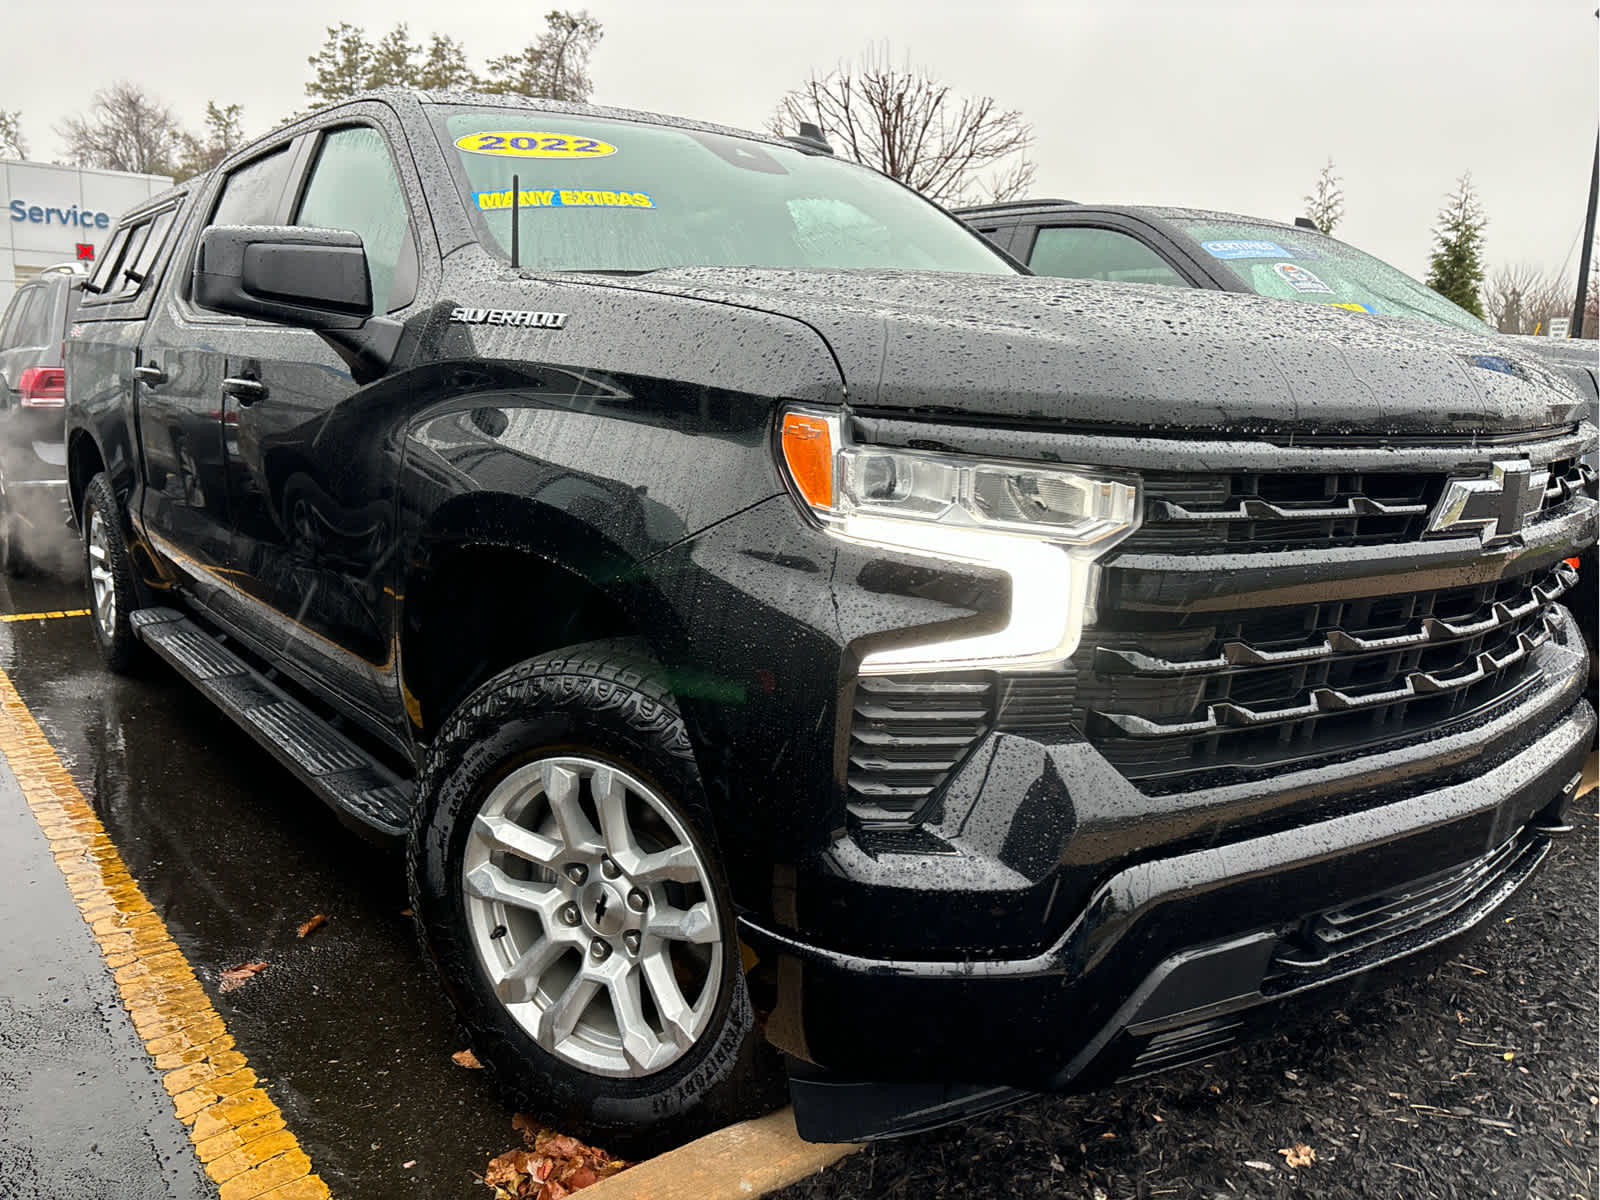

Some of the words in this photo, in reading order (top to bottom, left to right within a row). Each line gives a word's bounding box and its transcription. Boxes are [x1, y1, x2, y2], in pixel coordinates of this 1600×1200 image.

[477, 135, 601, 153] 2022
[477, 190, 555, 210] MANY
[560, 190, 653, 208] EXTRAS
[9, 199, 110, 229] Service
[449, 307, 568, 330] SILVERADO
